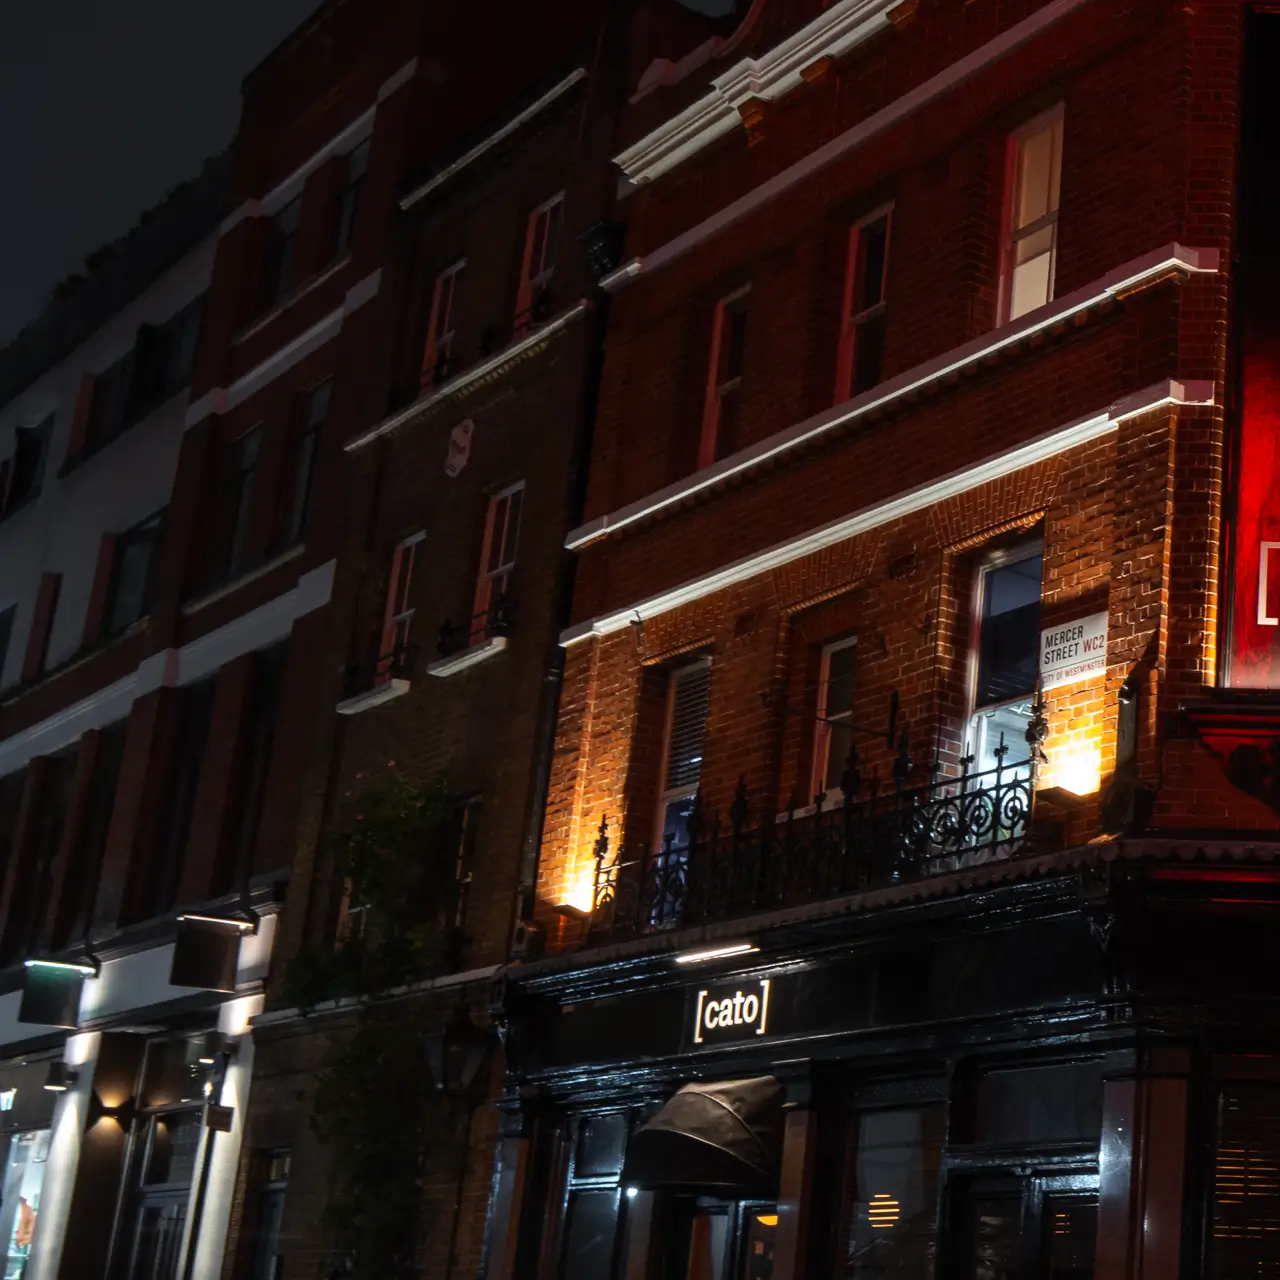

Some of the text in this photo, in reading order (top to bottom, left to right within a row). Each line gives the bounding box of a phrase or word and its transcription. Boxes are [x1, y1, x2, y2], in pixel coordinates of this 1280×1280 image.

[1044, 625, 1084, 649] MERCER
[1044, 634, 1105, 665] STREET WC2
[1043, 659, 1105, 684] CITY OF WESTMINSTER
